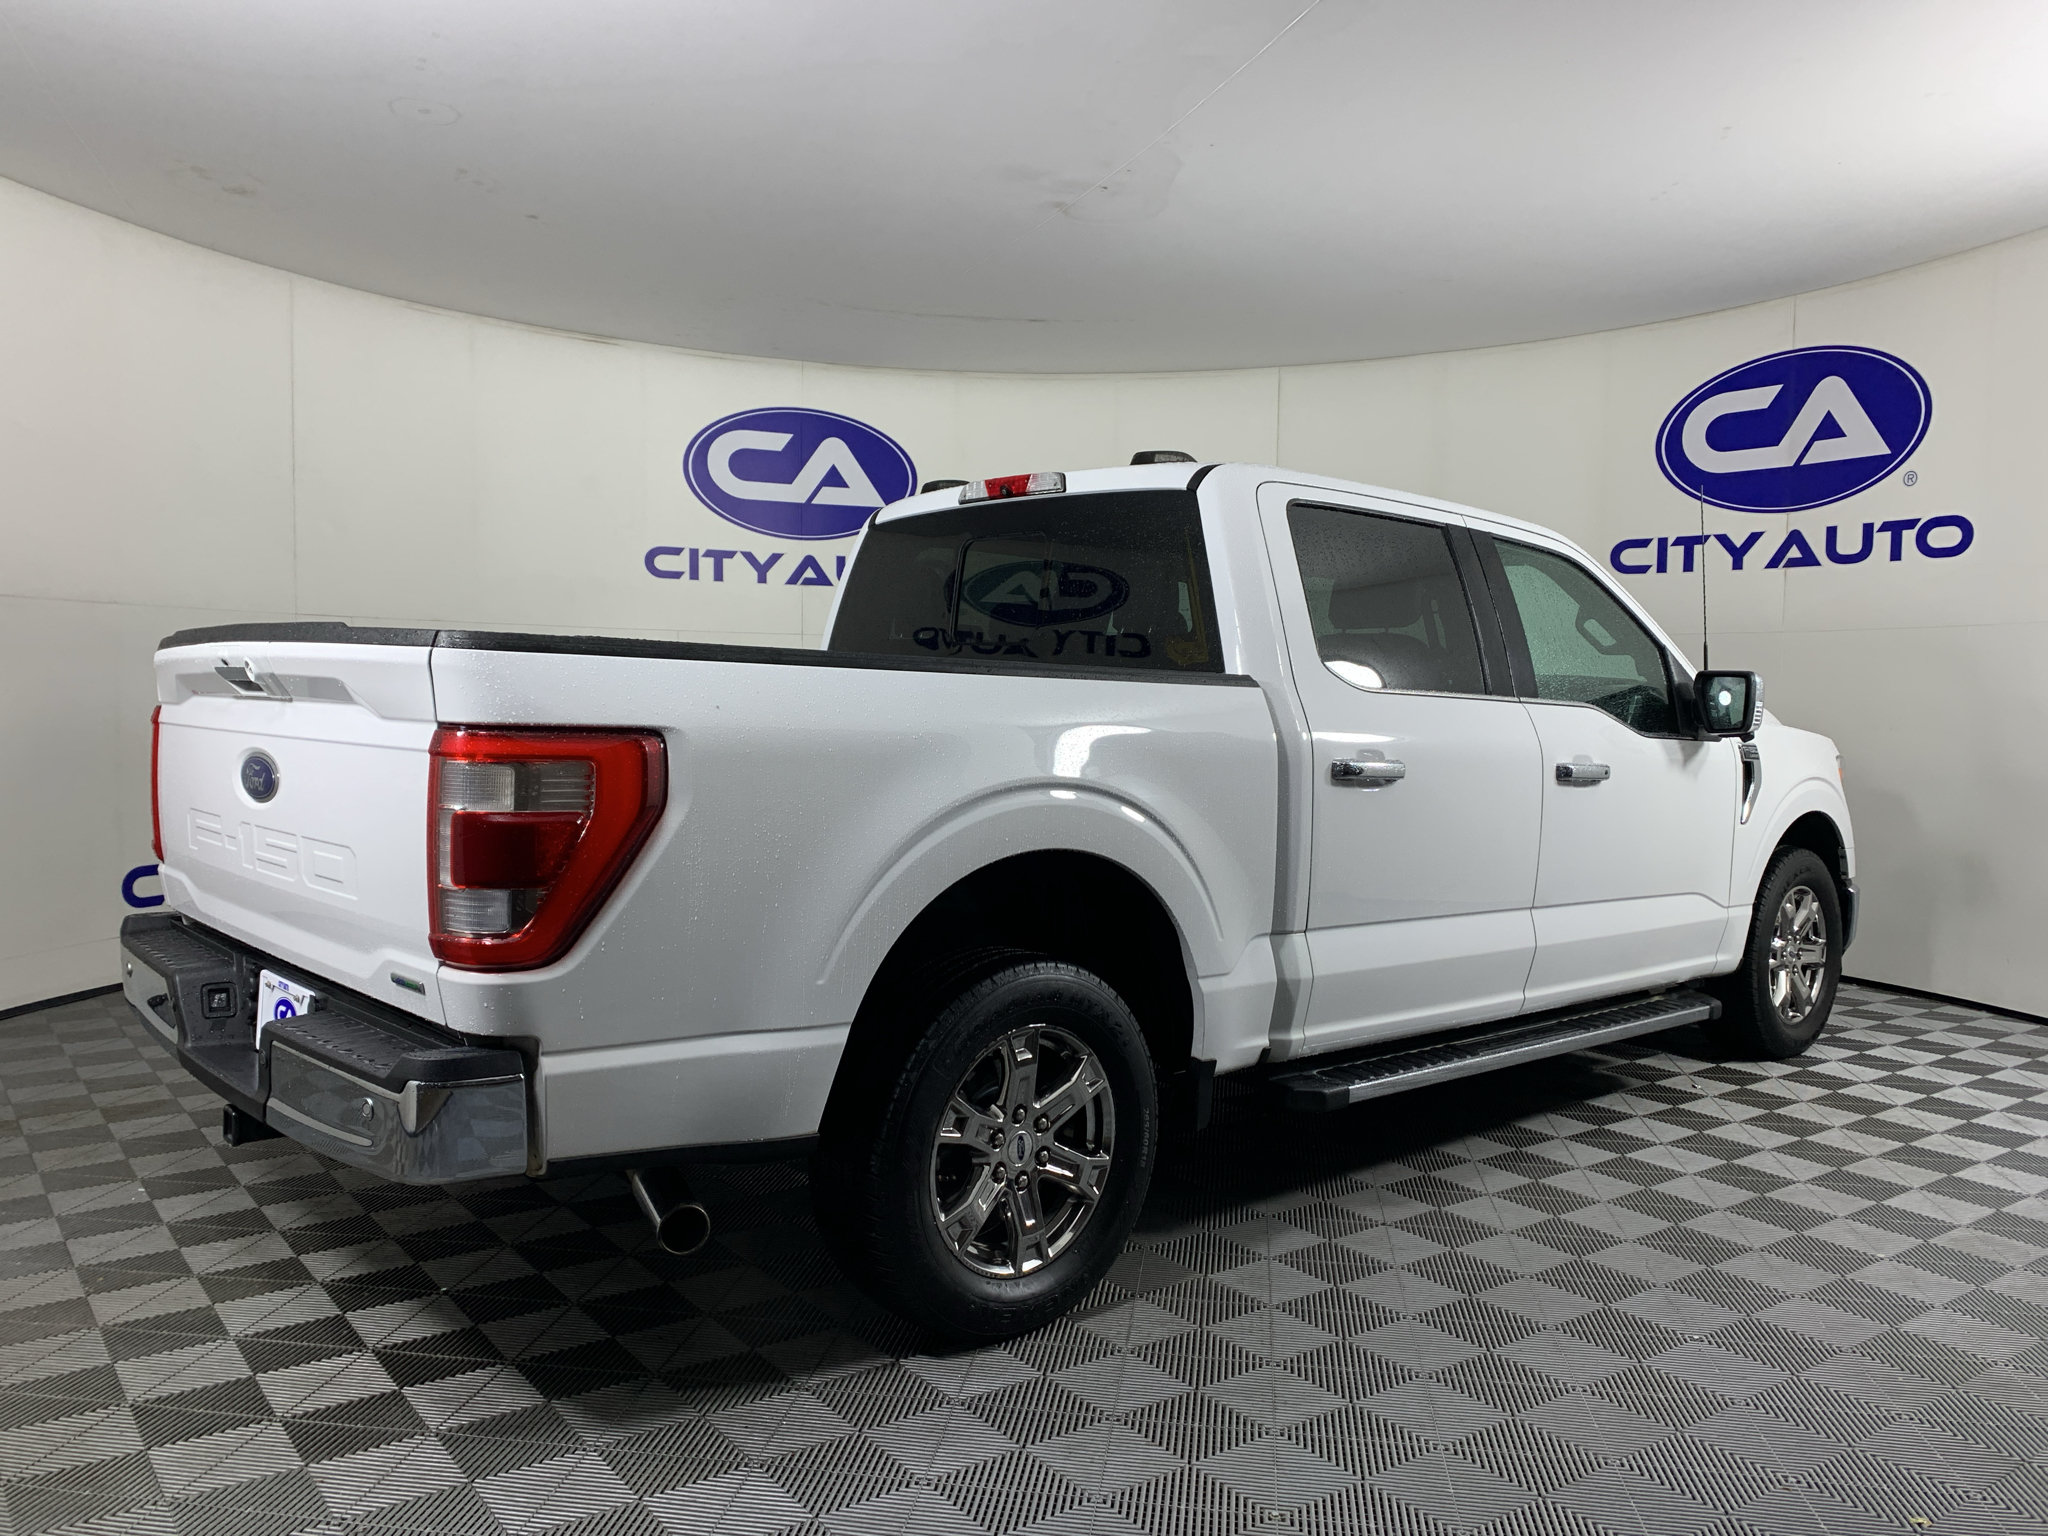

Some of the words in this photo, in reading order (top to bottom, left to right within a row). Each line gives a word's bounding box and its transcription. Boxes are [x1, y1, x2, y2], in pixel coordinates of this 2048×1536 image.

[706, 428, 886, 507] CA
[1682, 375, 1891, 474] CA
[187, 807, 358, 901] F-150
